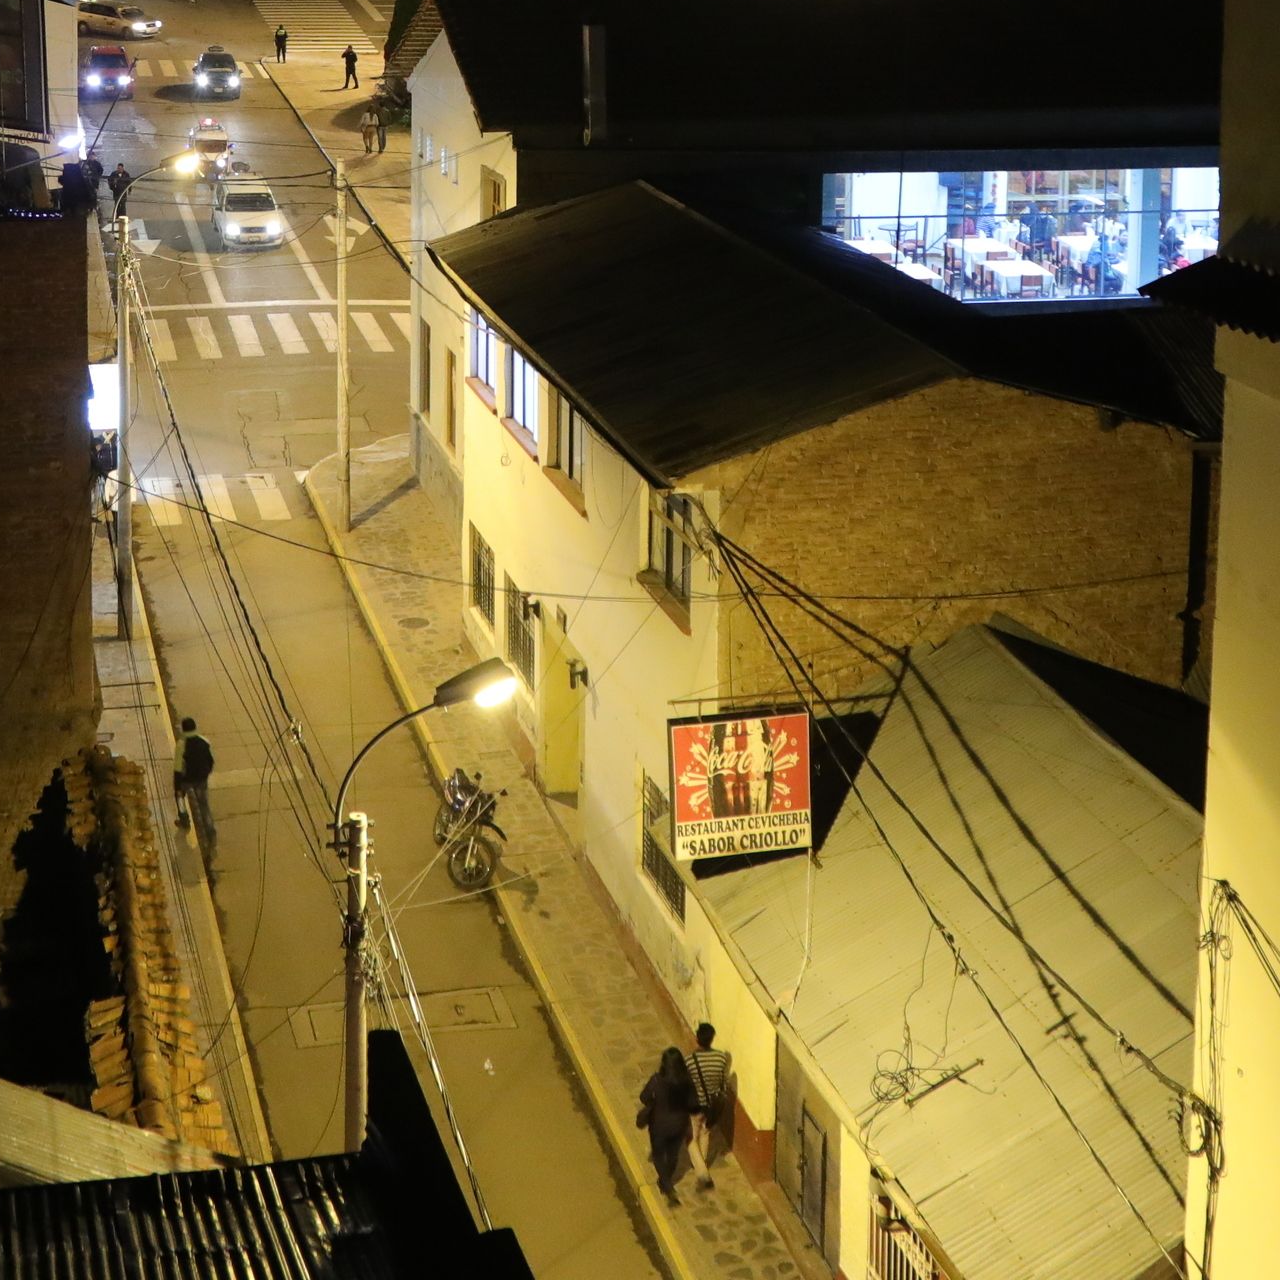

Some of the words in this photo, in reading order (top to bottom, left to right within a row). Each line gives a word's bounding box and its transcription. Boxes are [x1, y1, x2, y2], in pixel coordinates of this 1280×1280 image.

[707, 743, 773, 777] Coca-Cla
[677, 818, 747, 837] RESTAURANT
[748, 812, 810, 829] CEVICHERIA
[682, 837, 737, 856] “SABOR
[739, 829, 806, 851] CRIOLLO”
